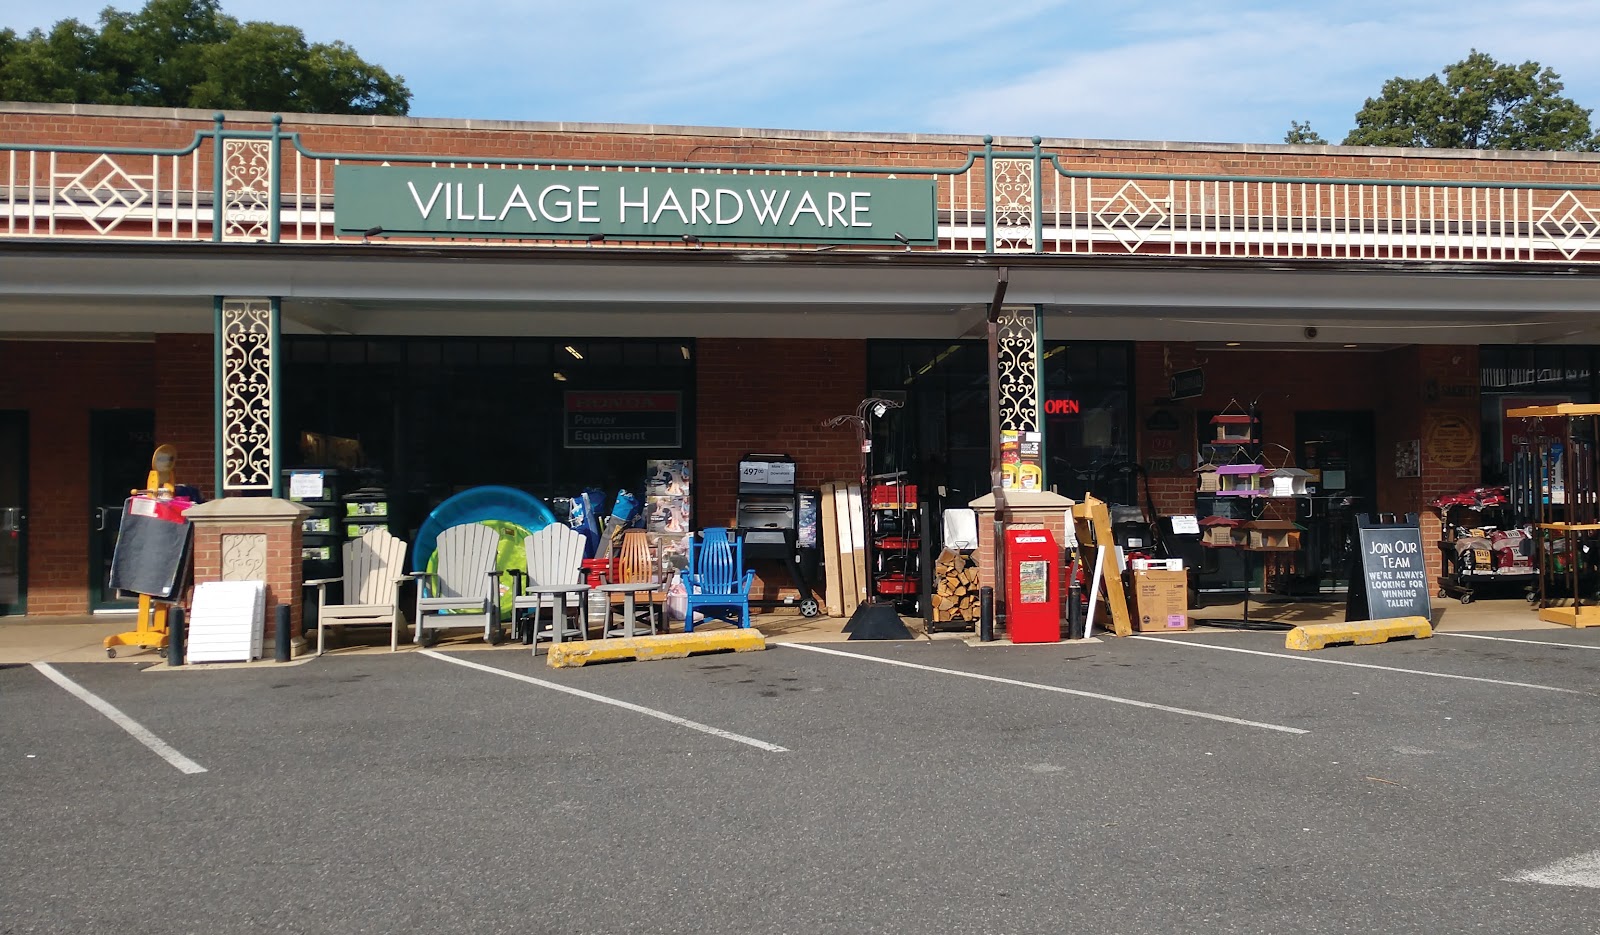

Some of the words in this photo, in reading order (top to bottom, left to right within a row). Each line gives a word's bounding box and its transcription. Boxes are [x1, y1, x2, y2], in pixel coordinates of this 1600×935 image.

[407, 181, 601, 223] VILLAGE
[619, 185, 873, 228] HARDWARE
[1044, 399, 1078, 413] OPEN
[574, 414, 616, 425] Power
[574, 430, 646, 443] Equipment
[1369, 541, 1393, 554] JOIN
[1394, 540, 1418, 554] OUR
[1380, 555, 1411, 568] TEAM
[1369, 571, 1393, 580] WE'RE
[1396, 570, 1424, 580] ALWAYS
[1371, 580, 1406, 589] LOOKING
[1409, 580, 1424, 588] FOR
[1381, 589, 1417, 598] WINNING
[1386, 599, 1414, 608] TALENT
